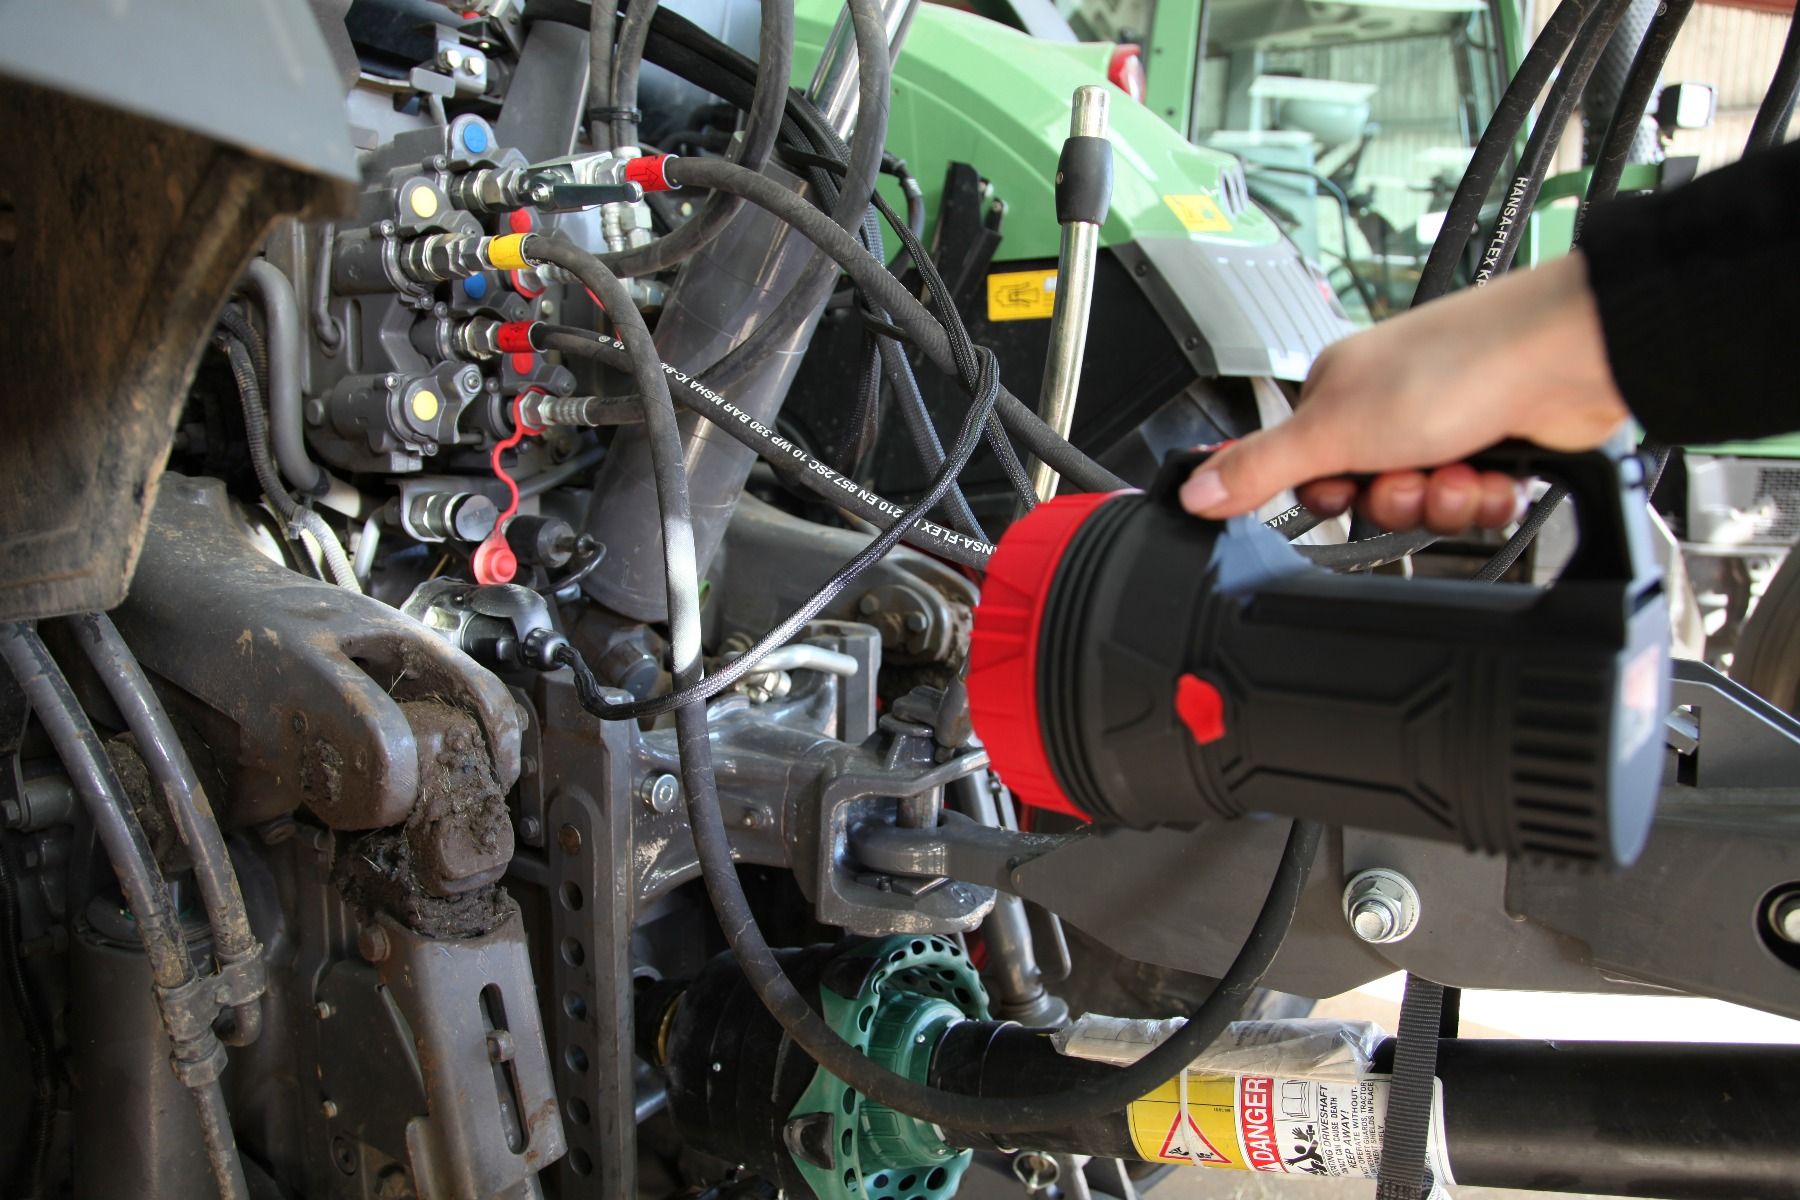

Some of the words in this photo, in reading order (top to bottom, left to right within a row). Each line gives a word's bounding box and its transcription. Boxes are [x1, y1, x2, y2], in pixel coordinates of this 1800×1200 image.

[1481, 177, 1529, 267] HANSA-FLEX
[1569, 201, 1590, 250] HANSA
[1475, 269, 1492, 288] KP
[660, 362, 690, 384] IC-84
[689, 380, 724, 406] MSHA
[723, 403, 751, 423] BAR
[750, 421, 773, 438] 330
[770, 436, 792, 452] WP
[792, 449, 808, 462] 10
[808, 460, 835, 479] 2SC
[833, 477, 858, 493] 857
[858, 489, 879, 506] EN
[878, 501, 904, 518] 210
[920, 522, 997, 555] NSA-FLEX
[1244, 1078, 1275, 1161] DANGER
[1319, 1085, 1333, 1148] DRIVESHAFT
[1368, 1106, 1374, 1114] IN
[1331, 1122, 1341, 1142] CAUSE
[1341, 1110, 1353, 1146] AWAY!
[1368, 1115, 1377, 1144] SHIELDS
[1354, 1131, 1366, 1163] OPERATE
[1344, 1148, 1357, 1169] KEEP
